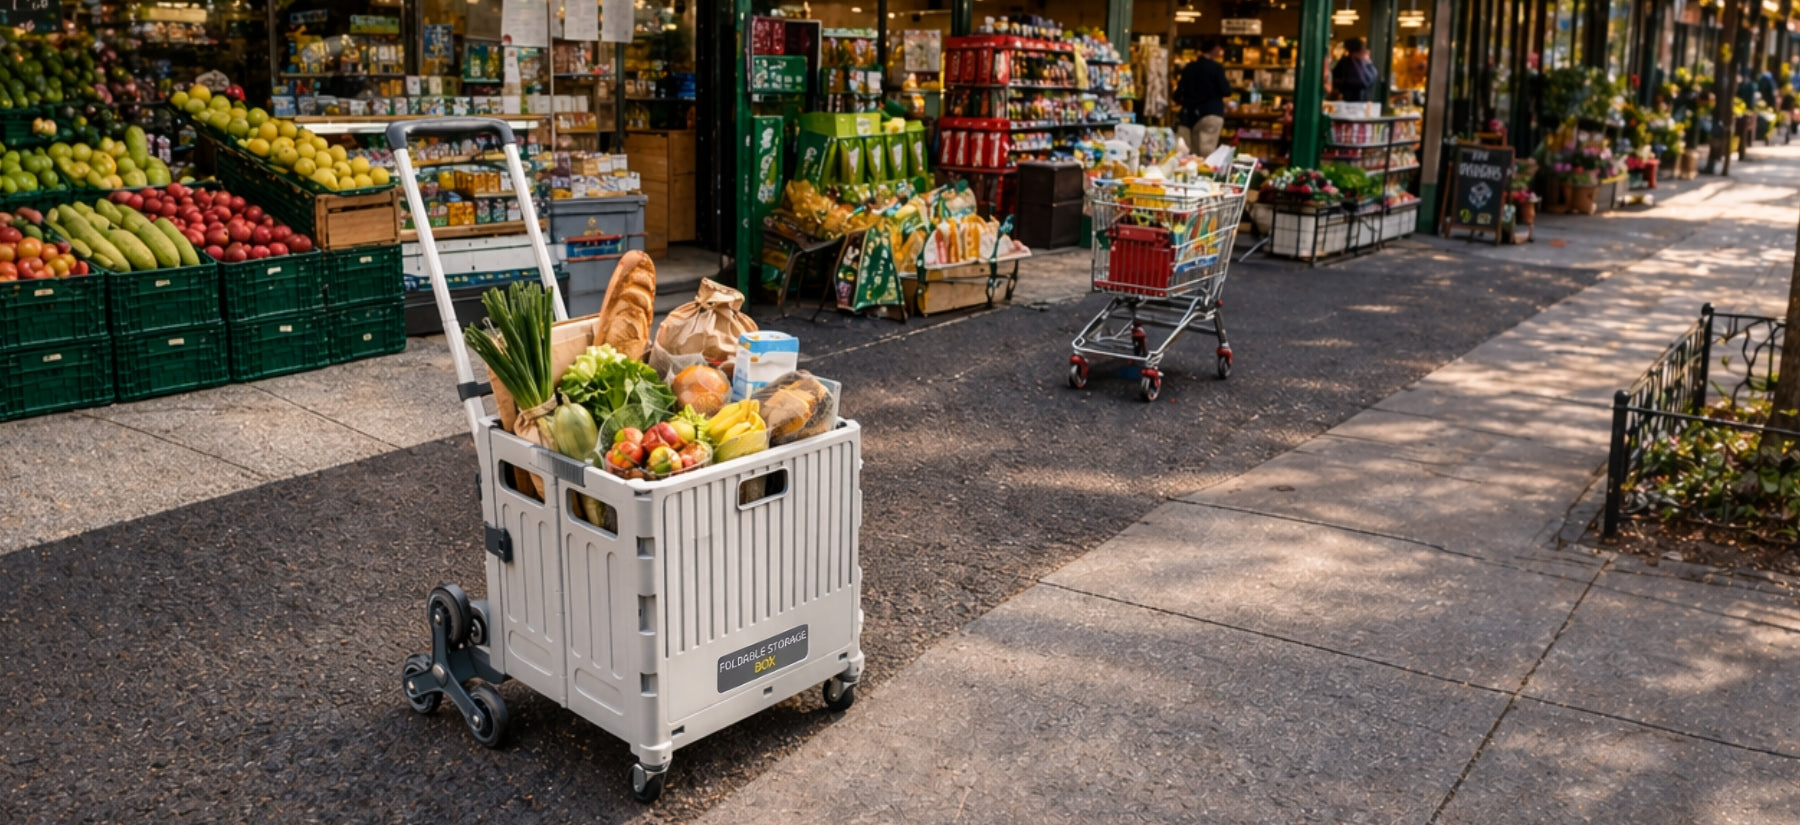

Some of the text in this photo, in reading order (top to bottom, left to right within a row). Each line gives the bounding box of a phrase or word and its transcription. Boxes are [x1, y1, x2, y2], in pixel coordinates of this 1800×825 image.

[719, 630, 807, 673] FOLDABLE STORAGE
[754, 655, 776, 673] BOX
